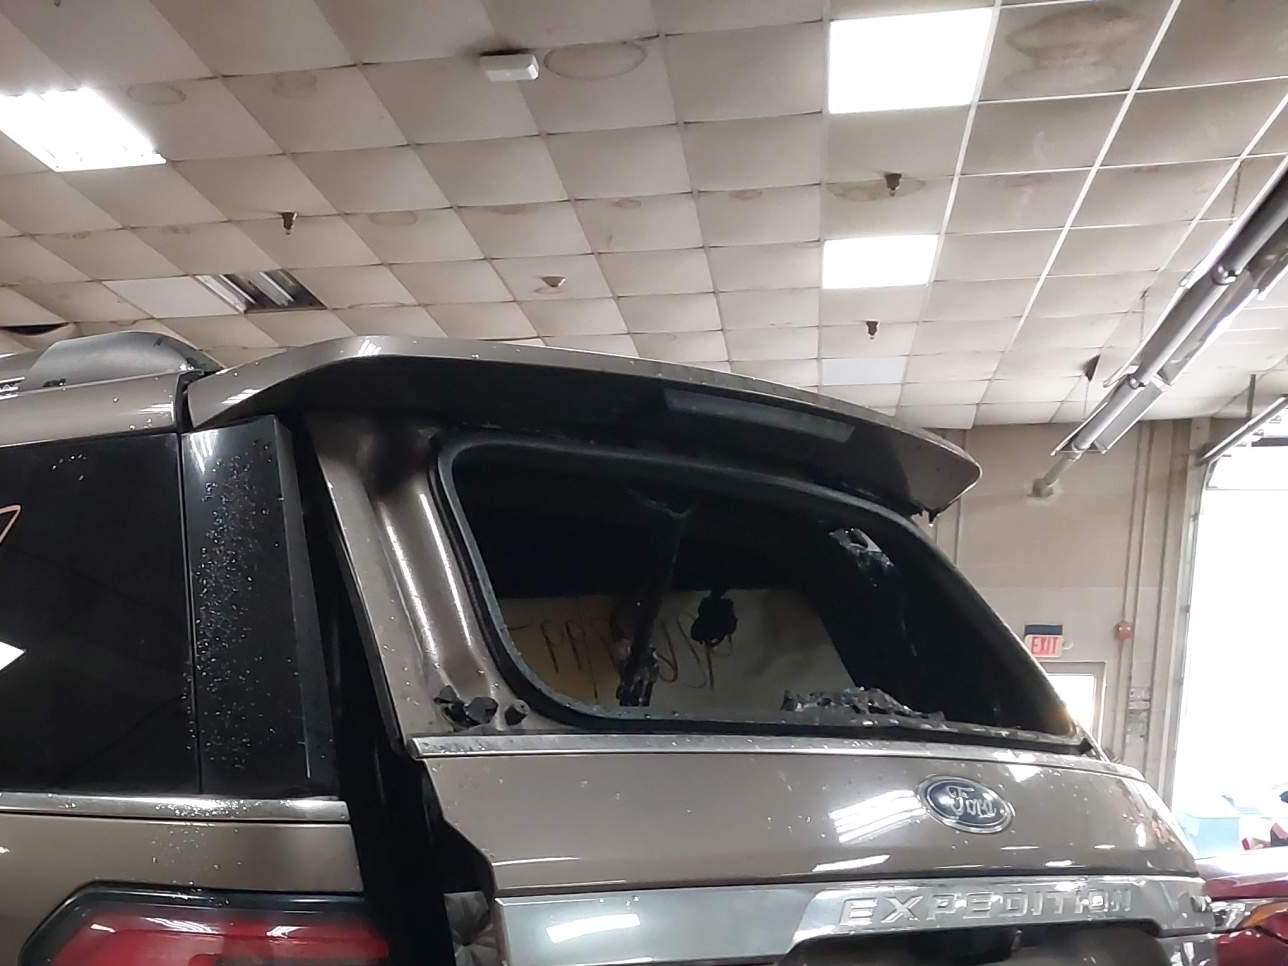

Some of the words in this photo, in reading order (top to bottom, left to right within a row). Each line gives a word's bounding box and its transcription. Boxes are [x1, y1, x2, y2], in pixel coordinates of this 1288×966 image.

[1031, 636, 1059, 655] EXIT
[946, 785, 997, 818] Ford
[839, 889, 1132, 926] EXPEDITION
